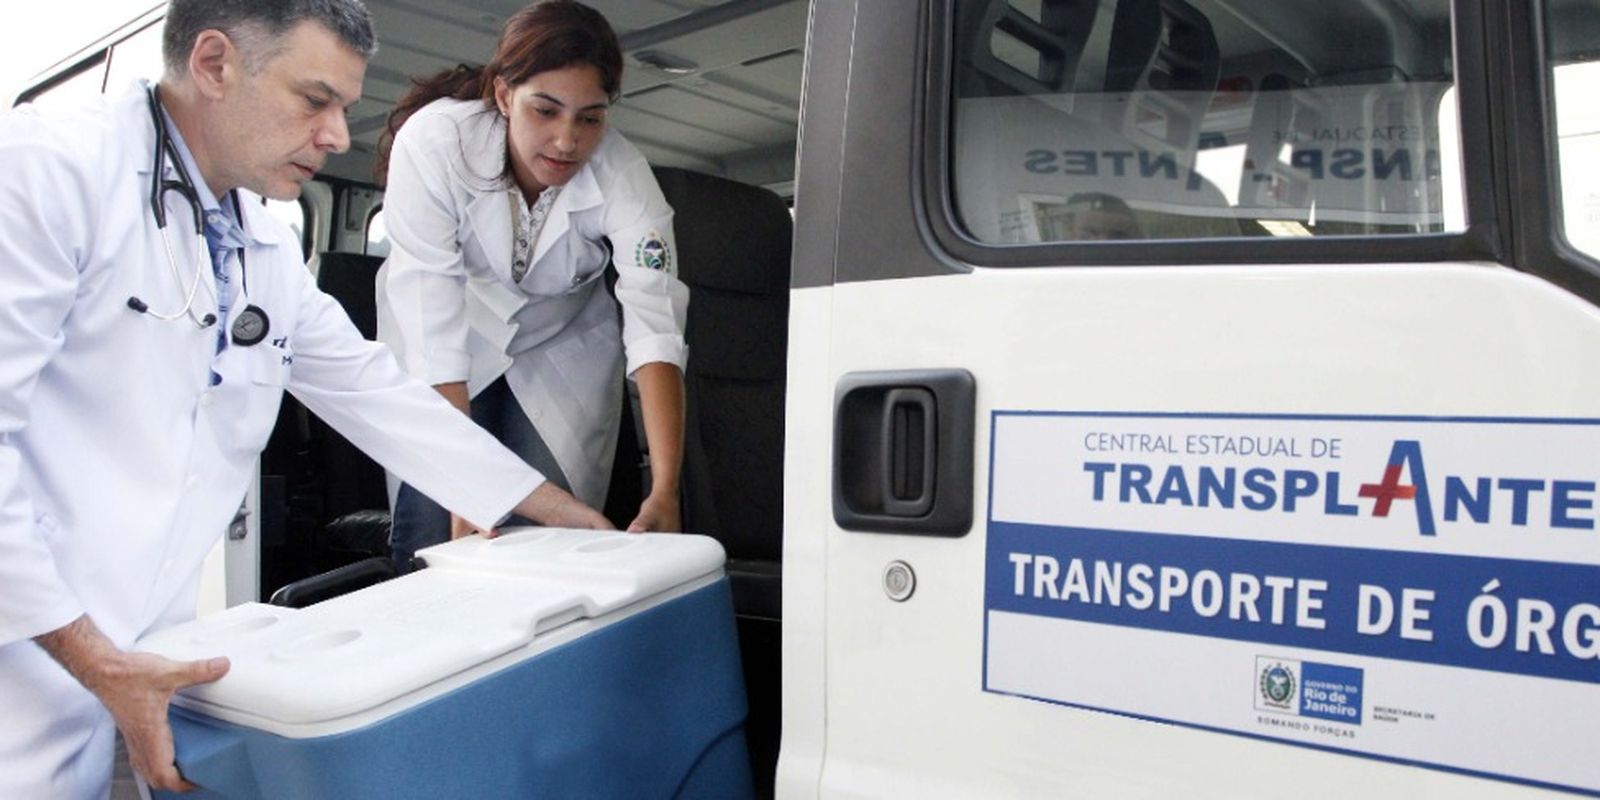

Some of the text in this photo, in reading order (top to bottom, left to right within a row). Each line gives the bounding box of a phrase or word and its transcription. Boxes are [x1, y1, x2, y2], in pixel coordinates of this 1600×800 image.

[1084, 432, 1342, 459] CENTRAL ESTADUAL DE
[1009, 552, 1600, 660] TRANSPORTE DE ÓRG
[1304, 688, 1347, 704] Rio de
[1304, 700, 1357, 717] Janeiro
[1257, 715, 1356, 738] SOMANDO FORÇAS
